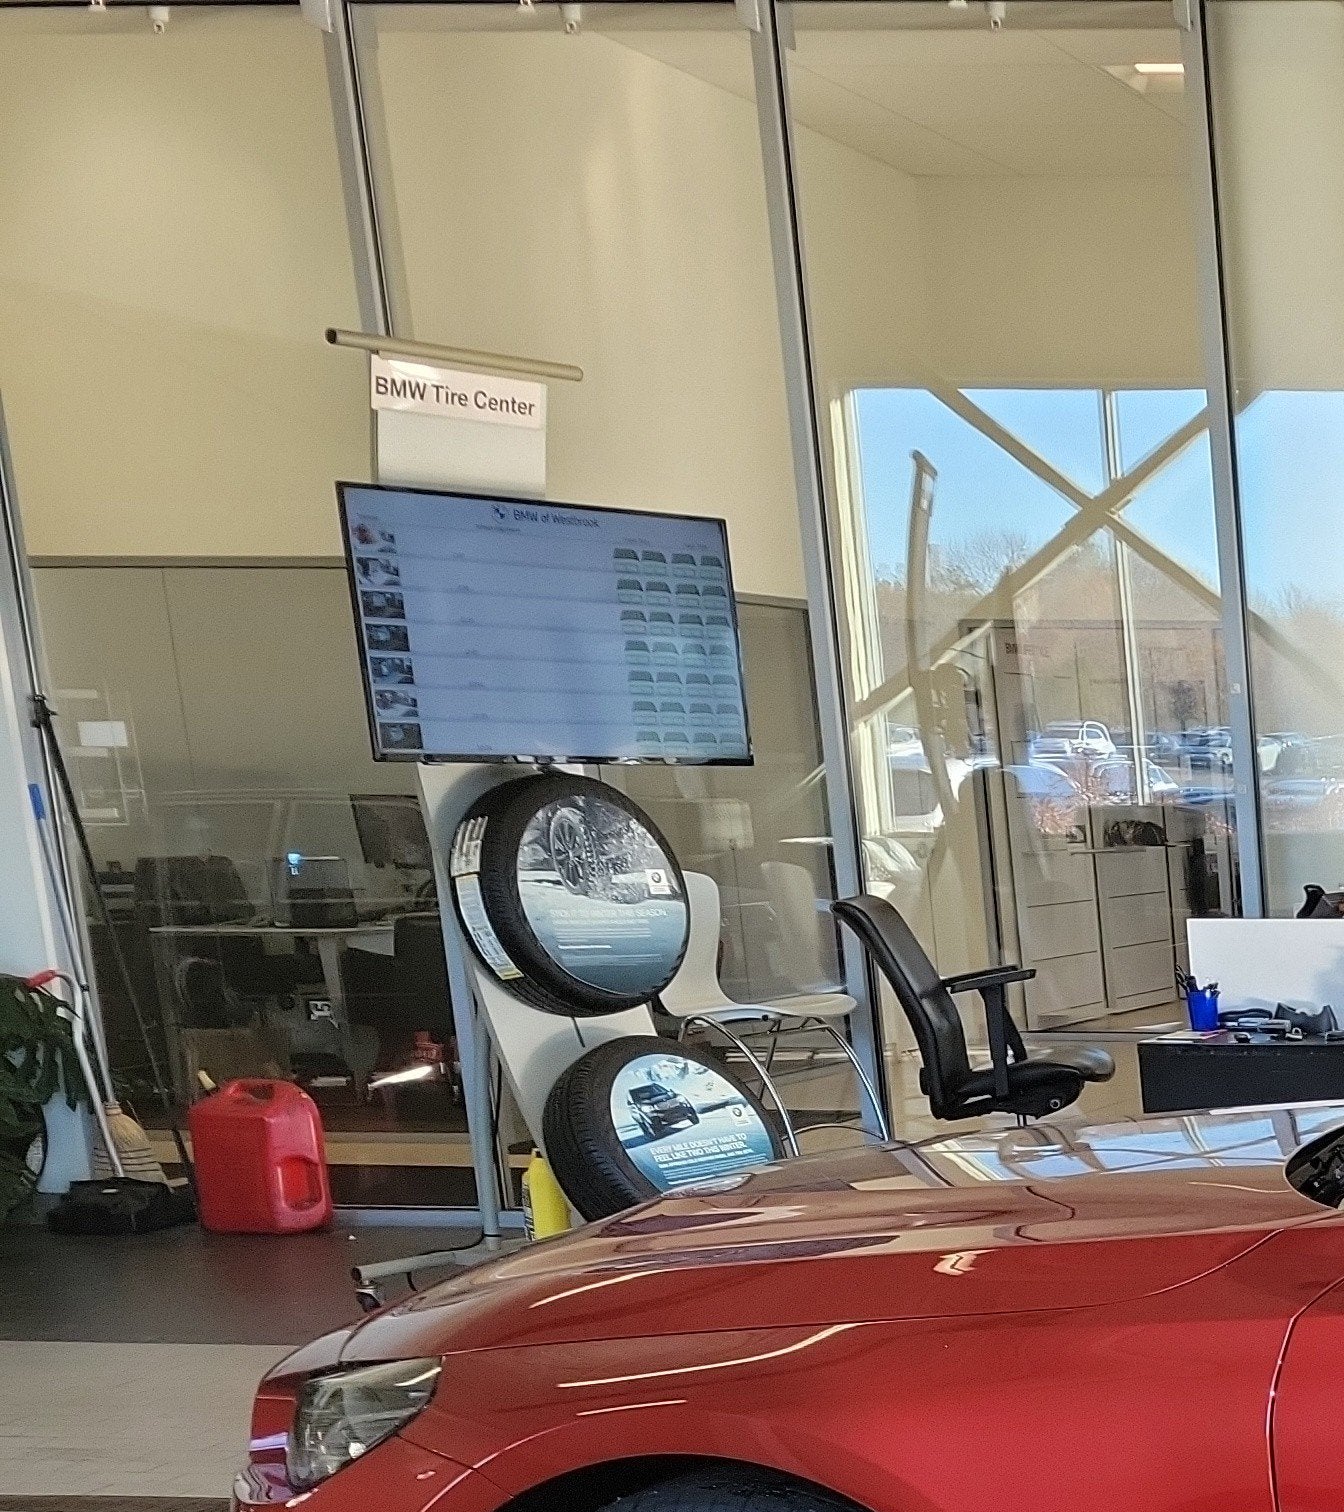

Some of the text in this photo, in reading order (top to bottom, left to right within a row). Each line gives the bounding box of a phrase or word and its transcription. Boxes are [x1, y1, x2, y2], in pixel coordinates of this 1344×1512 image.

[375, 375, 536, 416] BMW Tire Center
[513, 508, 600, 529] BMW of Westbrook
[736, 1132, 747, 1141] TO
